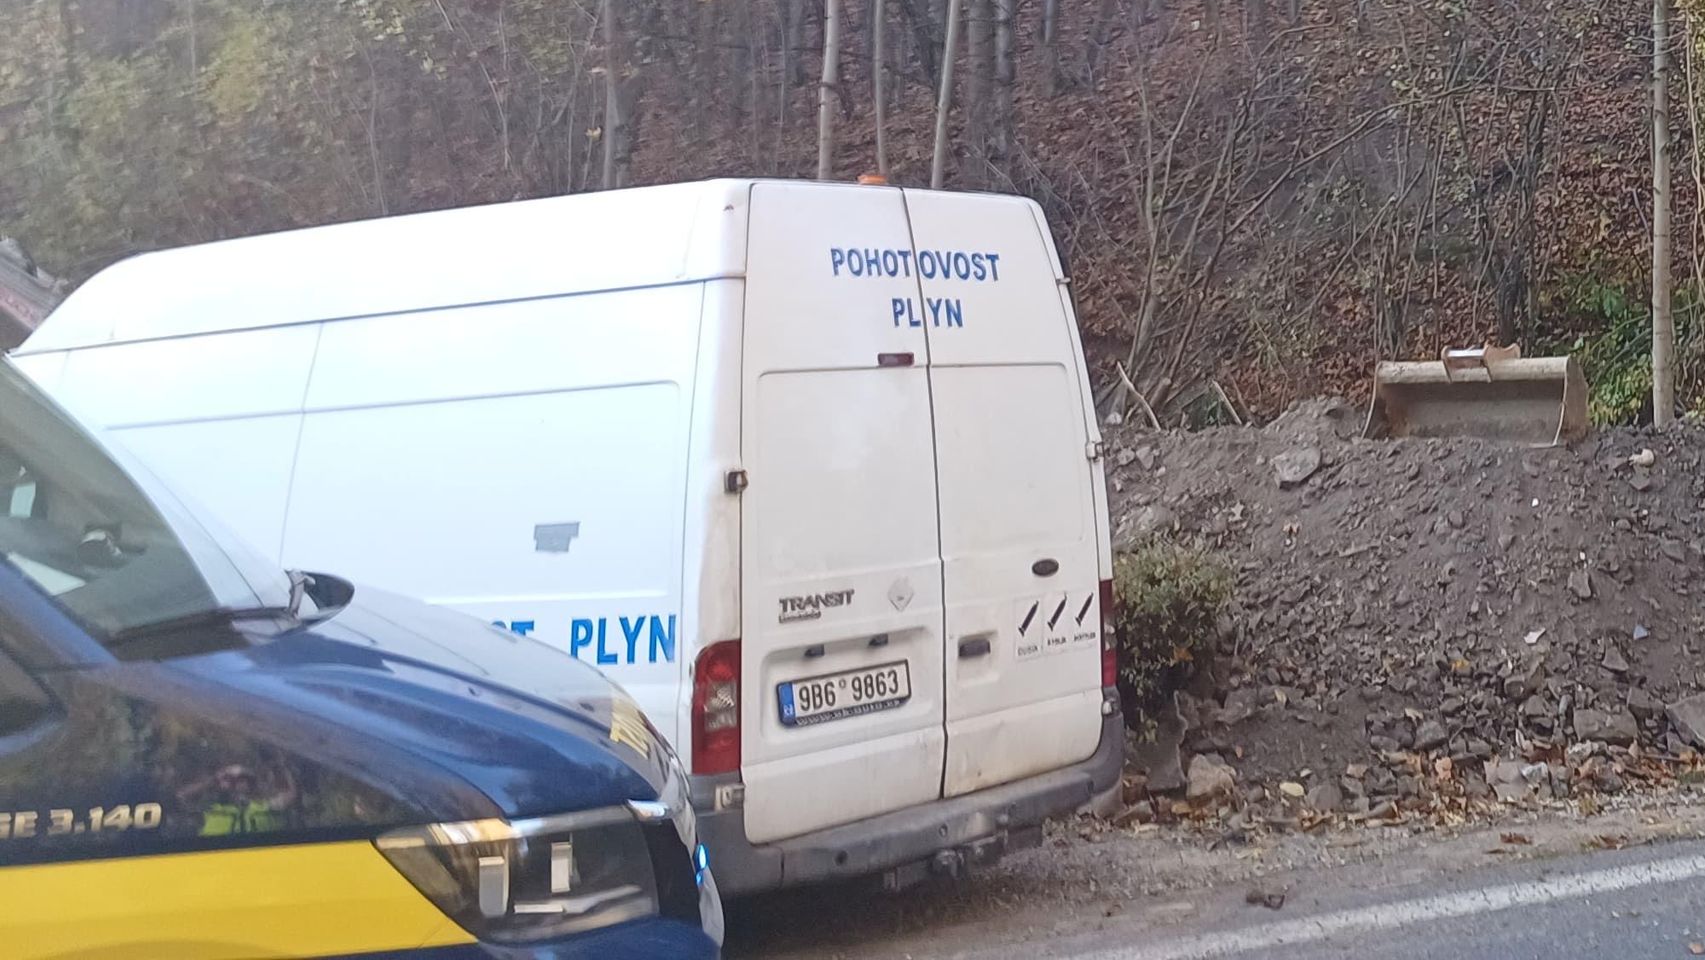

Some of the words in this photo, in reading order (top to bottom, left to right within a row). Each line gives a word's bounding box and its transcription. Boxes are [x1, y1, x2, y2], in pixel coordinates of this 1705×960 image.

[830, 248, 1000, 282] POHOTOVOST
[891, 297, 963, 328] PLYN
[778, 588, 856, 613] TRANSIT
[570, 613, 677, 665] PLYN
[798, 681, 836, 712] 9B6
[851, 669, 899, 701] 9863
[48, 802, 162, 836] 3.140
